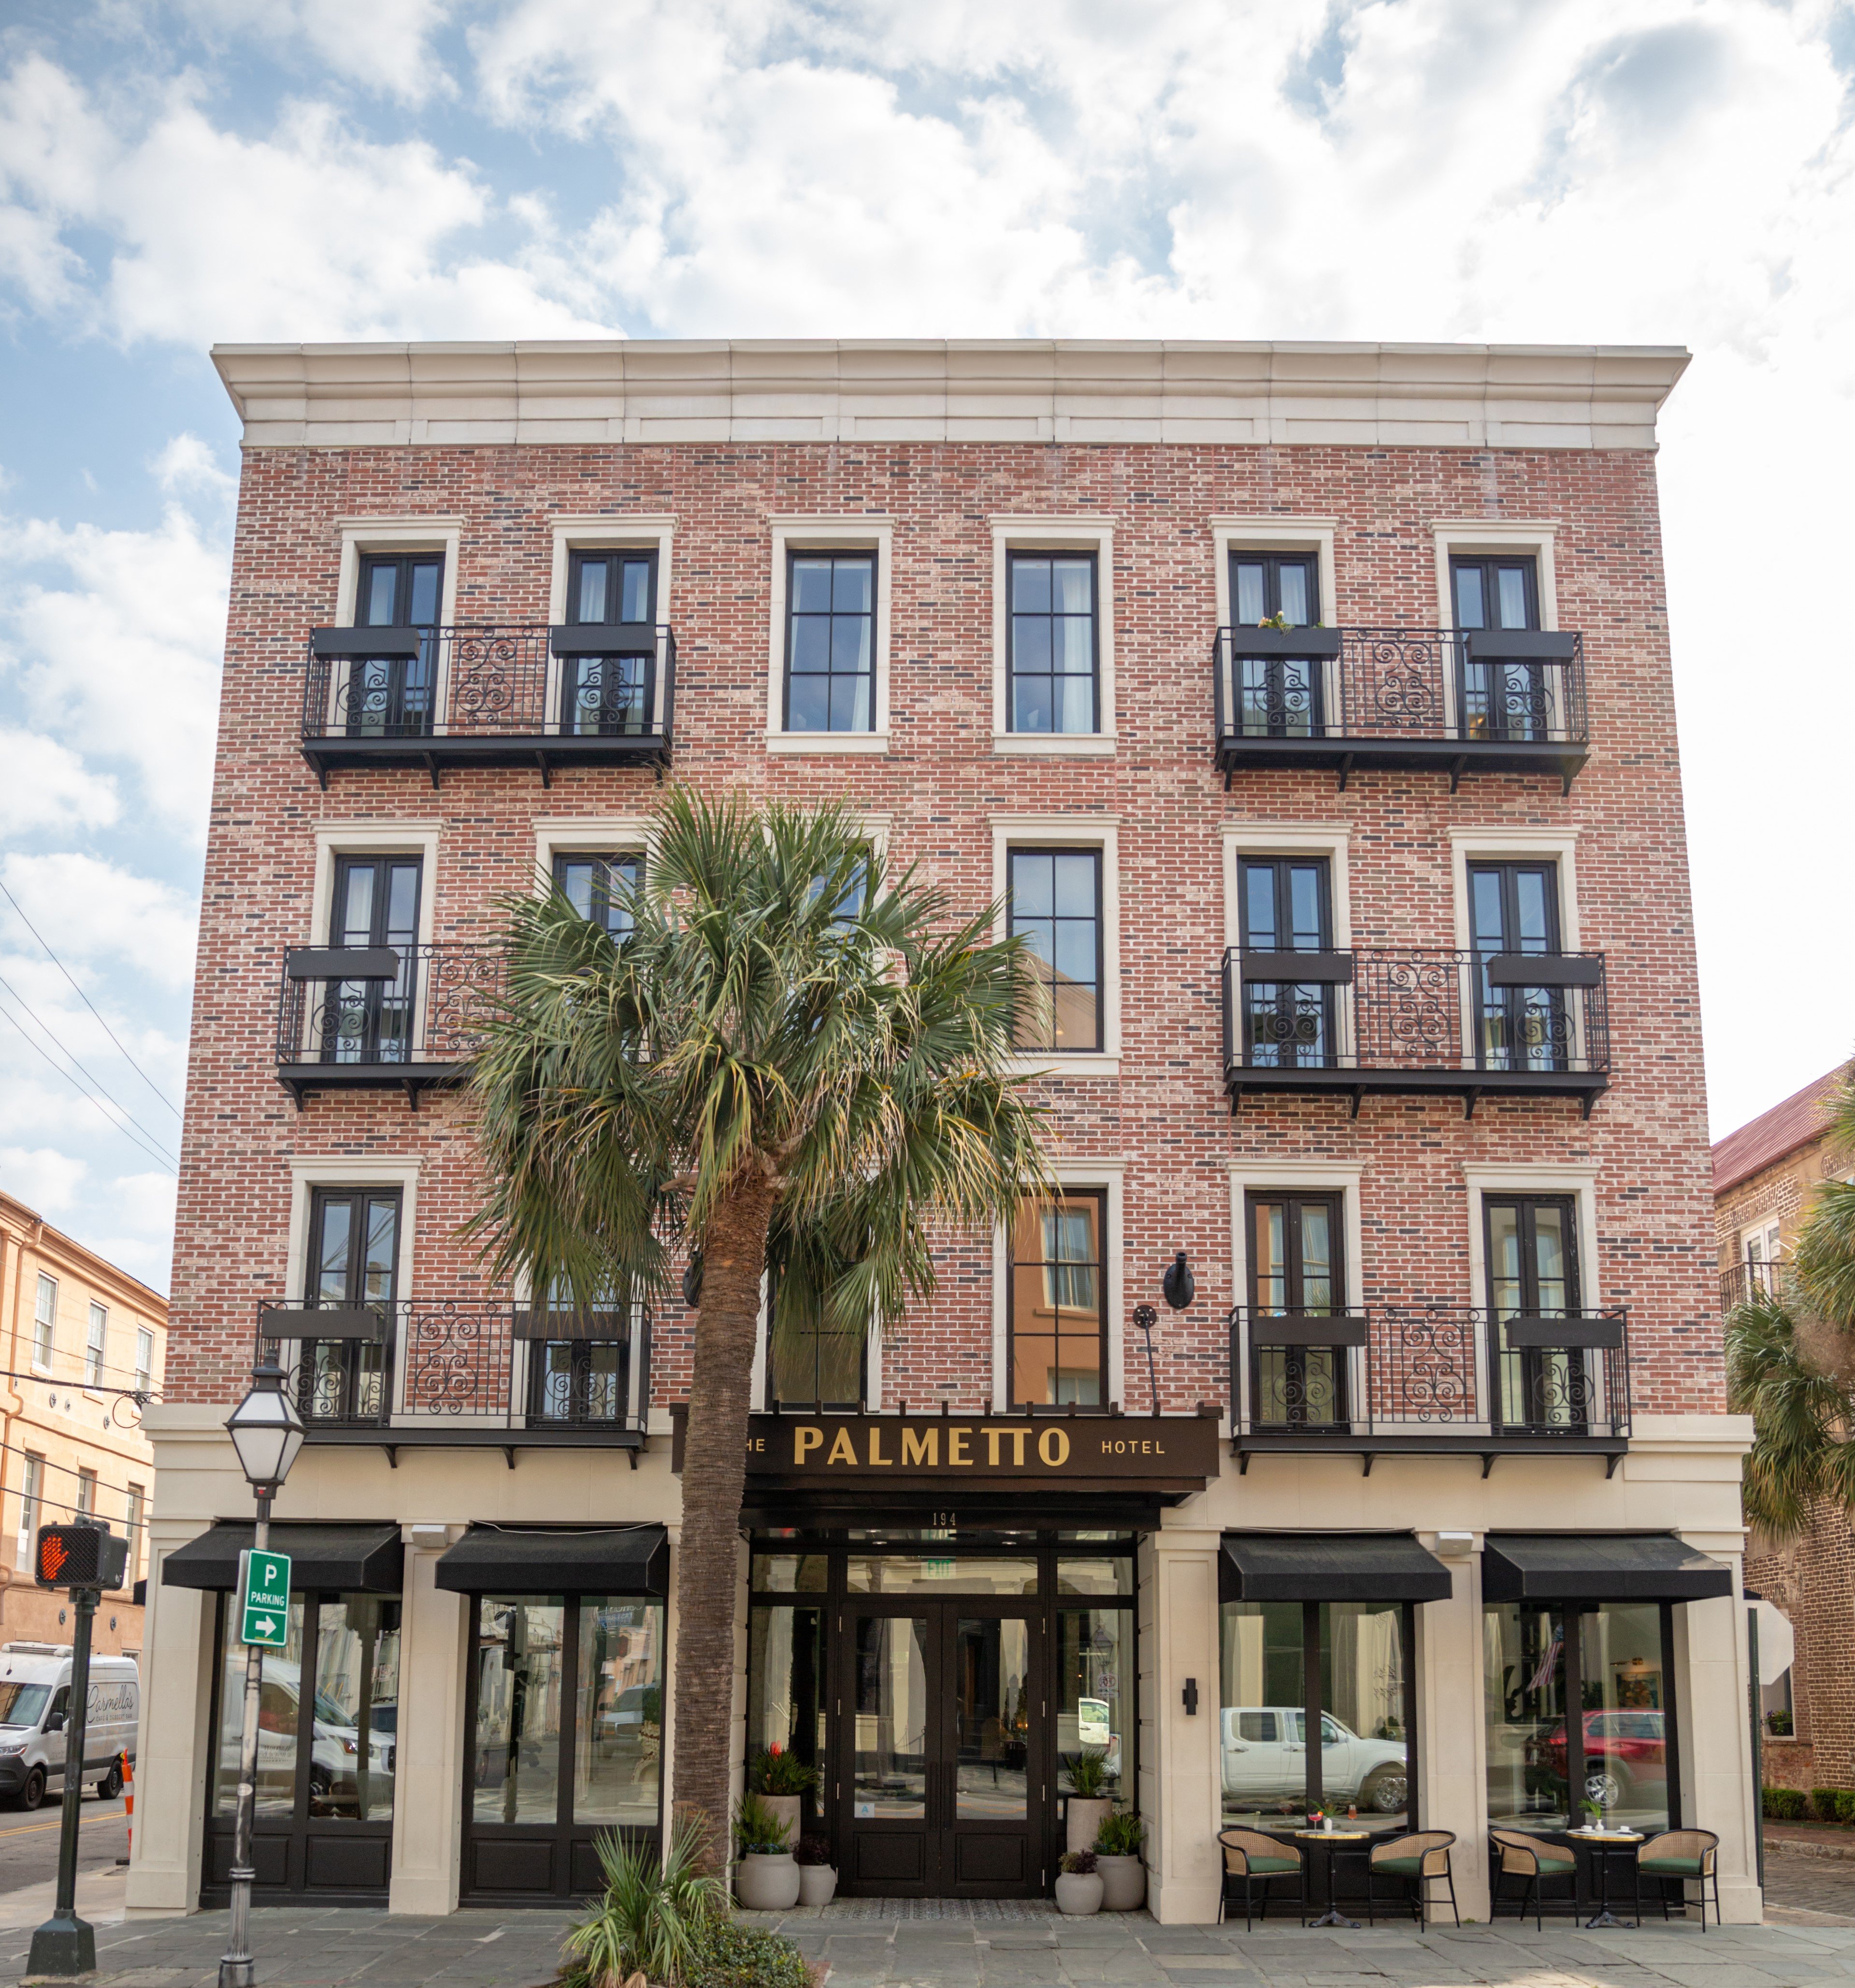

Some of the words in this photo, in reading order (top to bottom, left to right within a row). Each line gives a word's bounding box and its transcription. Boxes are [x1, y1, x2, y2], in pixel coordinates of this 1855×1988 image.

[746, 1439, 765, 1451] HE
[794, 1427, 1070, 1466] PALMETTO
[1102, 1441, 1165, 1454] HOTEL
[933, 1513, 956, 1526] 194
[264, 1564, 277, 1586] P
[928, 1560, 951, 1577] EXIT
[251, 1591, 285, 1606] PARKING
